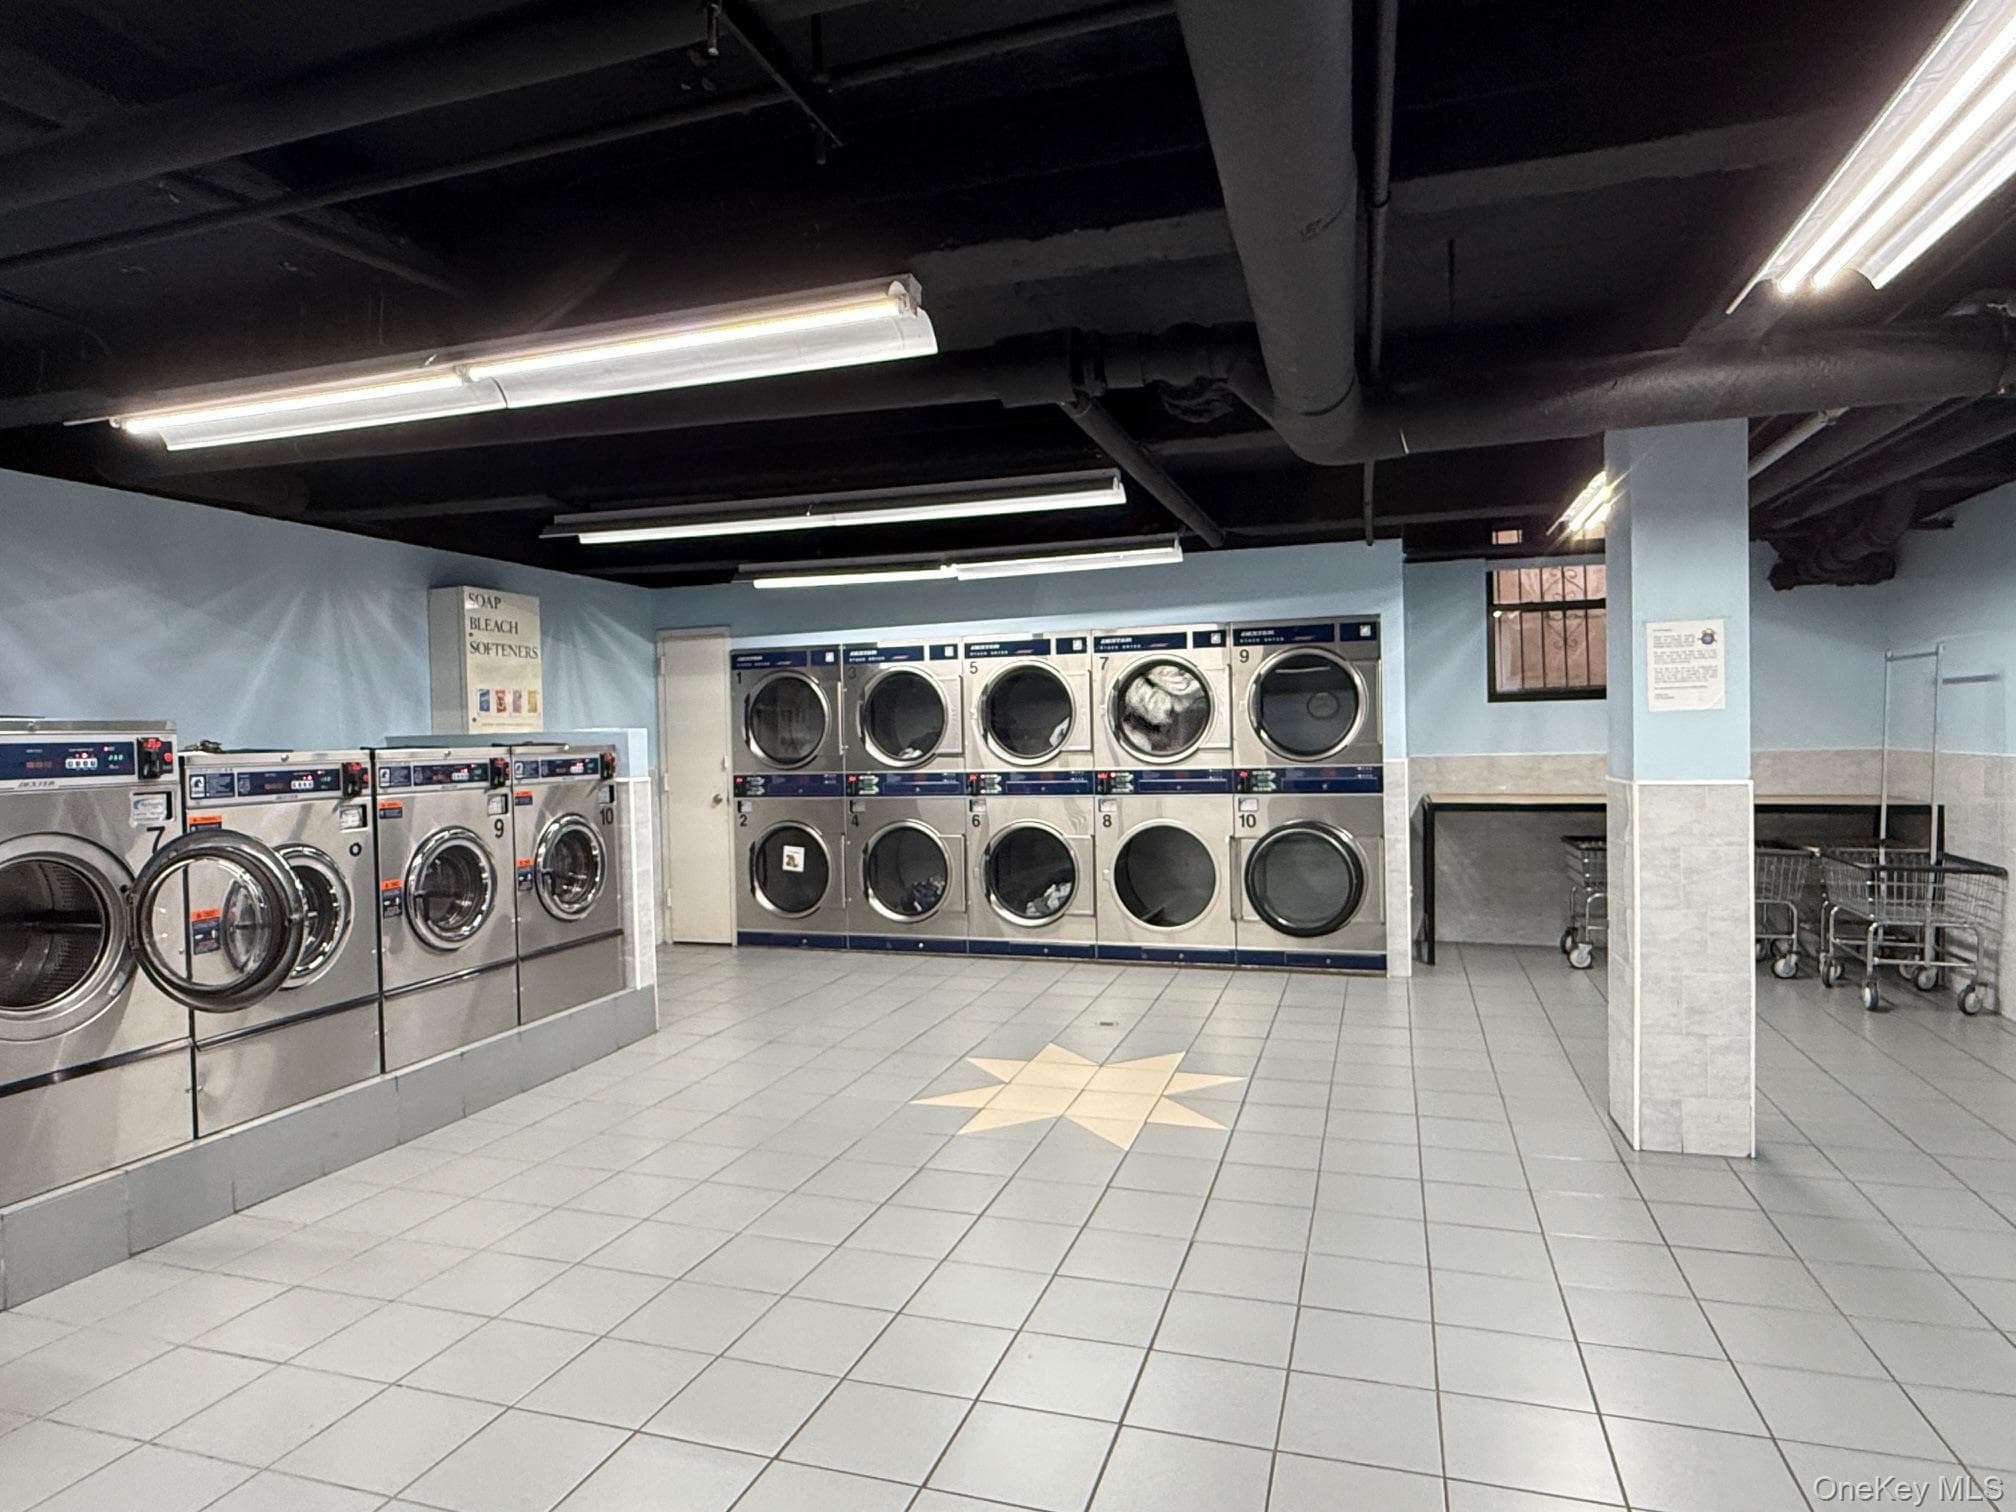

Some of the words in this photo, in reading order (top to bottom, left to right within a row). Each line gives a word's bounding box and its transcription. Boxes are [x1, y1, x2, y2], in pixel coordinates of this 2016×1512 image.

[468, 592, 501, 610] SOAP
[469, 616, 519, 634] BLEACH
[469, 641, 539, 659] SOFTENERS
[1239, 649, 1249, 663] 9
[970, 661, 978, 674] 5
[1099, 656, 1109, 670] 7
[736, 671, 742, 684] 1
[848, 666, 856, 679] 3
[600, 807, 614, 825] 10
[739, 814, 747, 827] 2
[851, 814, 859, 827] 4
[971, 814, 980, 827] 6
[1102, 814, 1112, 828] 8
[1239, 814, 1256, 828] 10
[494, 818, 504, 838] 9
[146, 825, 165, 855] 7
